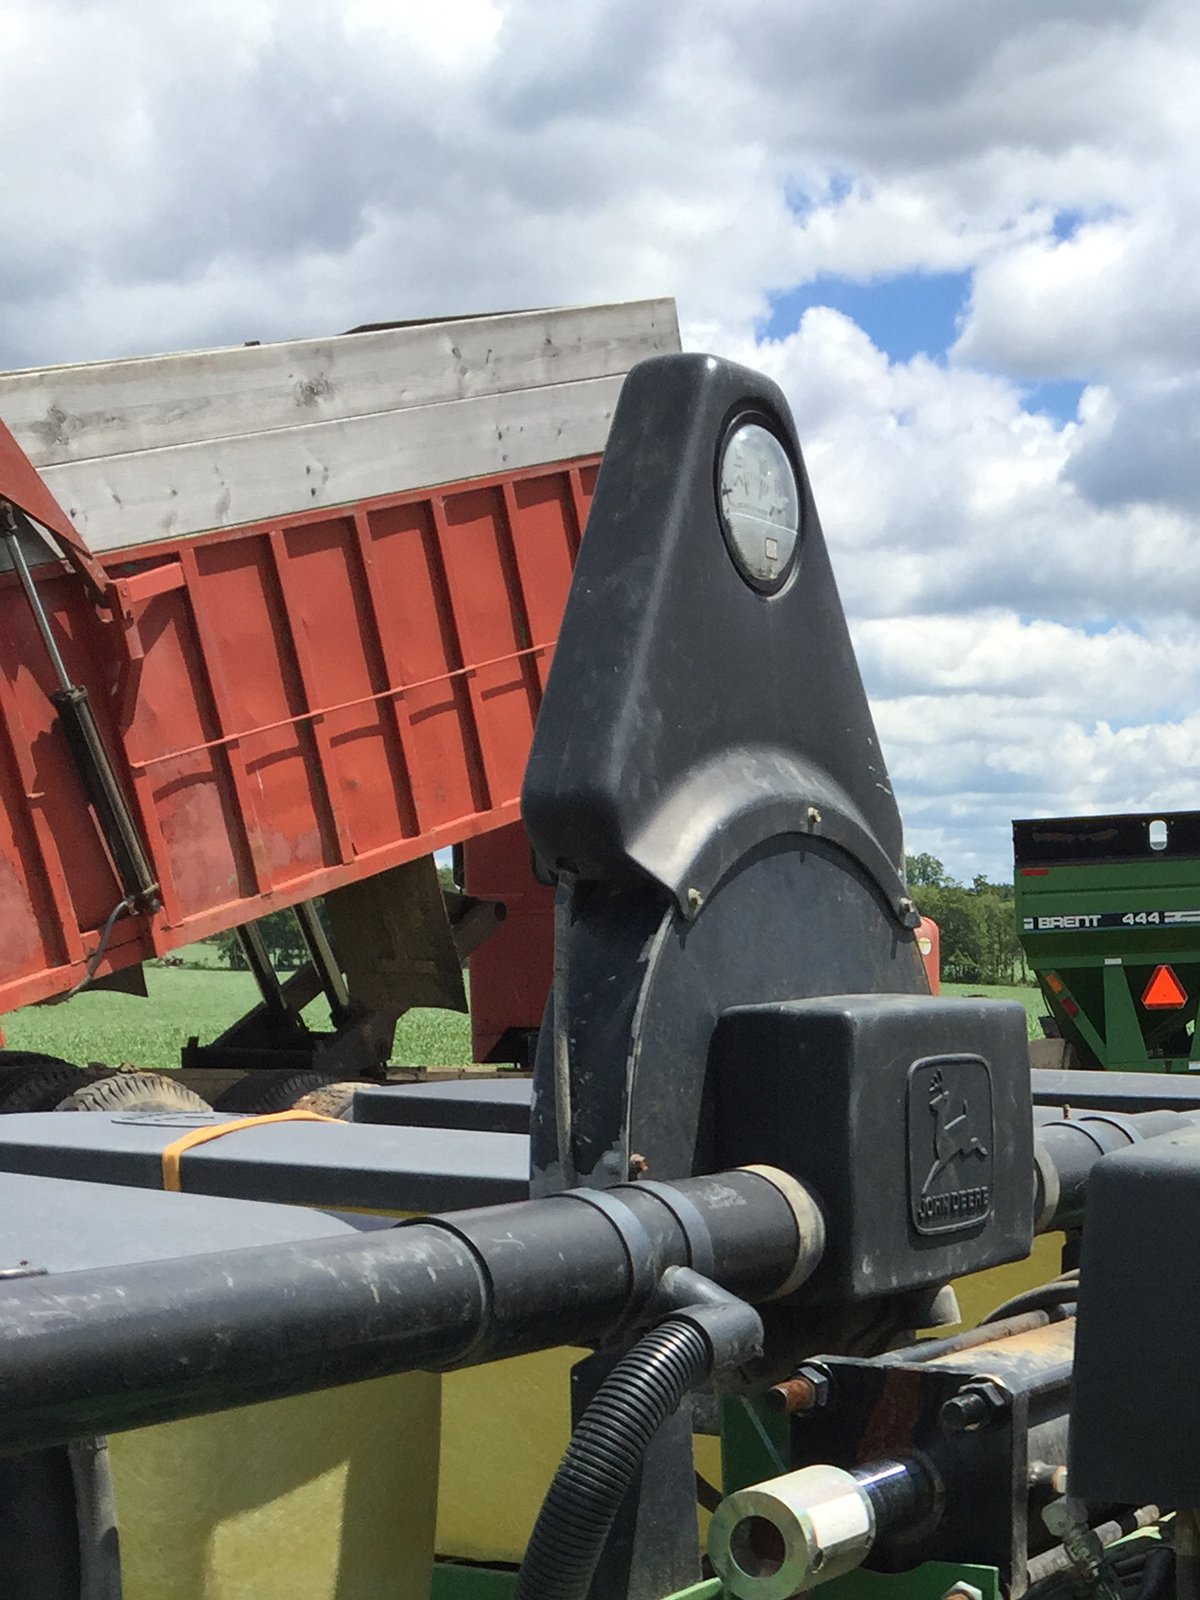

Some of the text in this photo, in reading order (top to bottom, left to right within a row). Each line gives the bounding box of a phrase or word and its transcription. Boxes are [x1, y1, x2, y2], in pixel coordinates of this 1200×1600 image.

[1038, 912, 1160, 929] BRENT 444
[917, 1186, 990, 1220] JOHN DEERE
